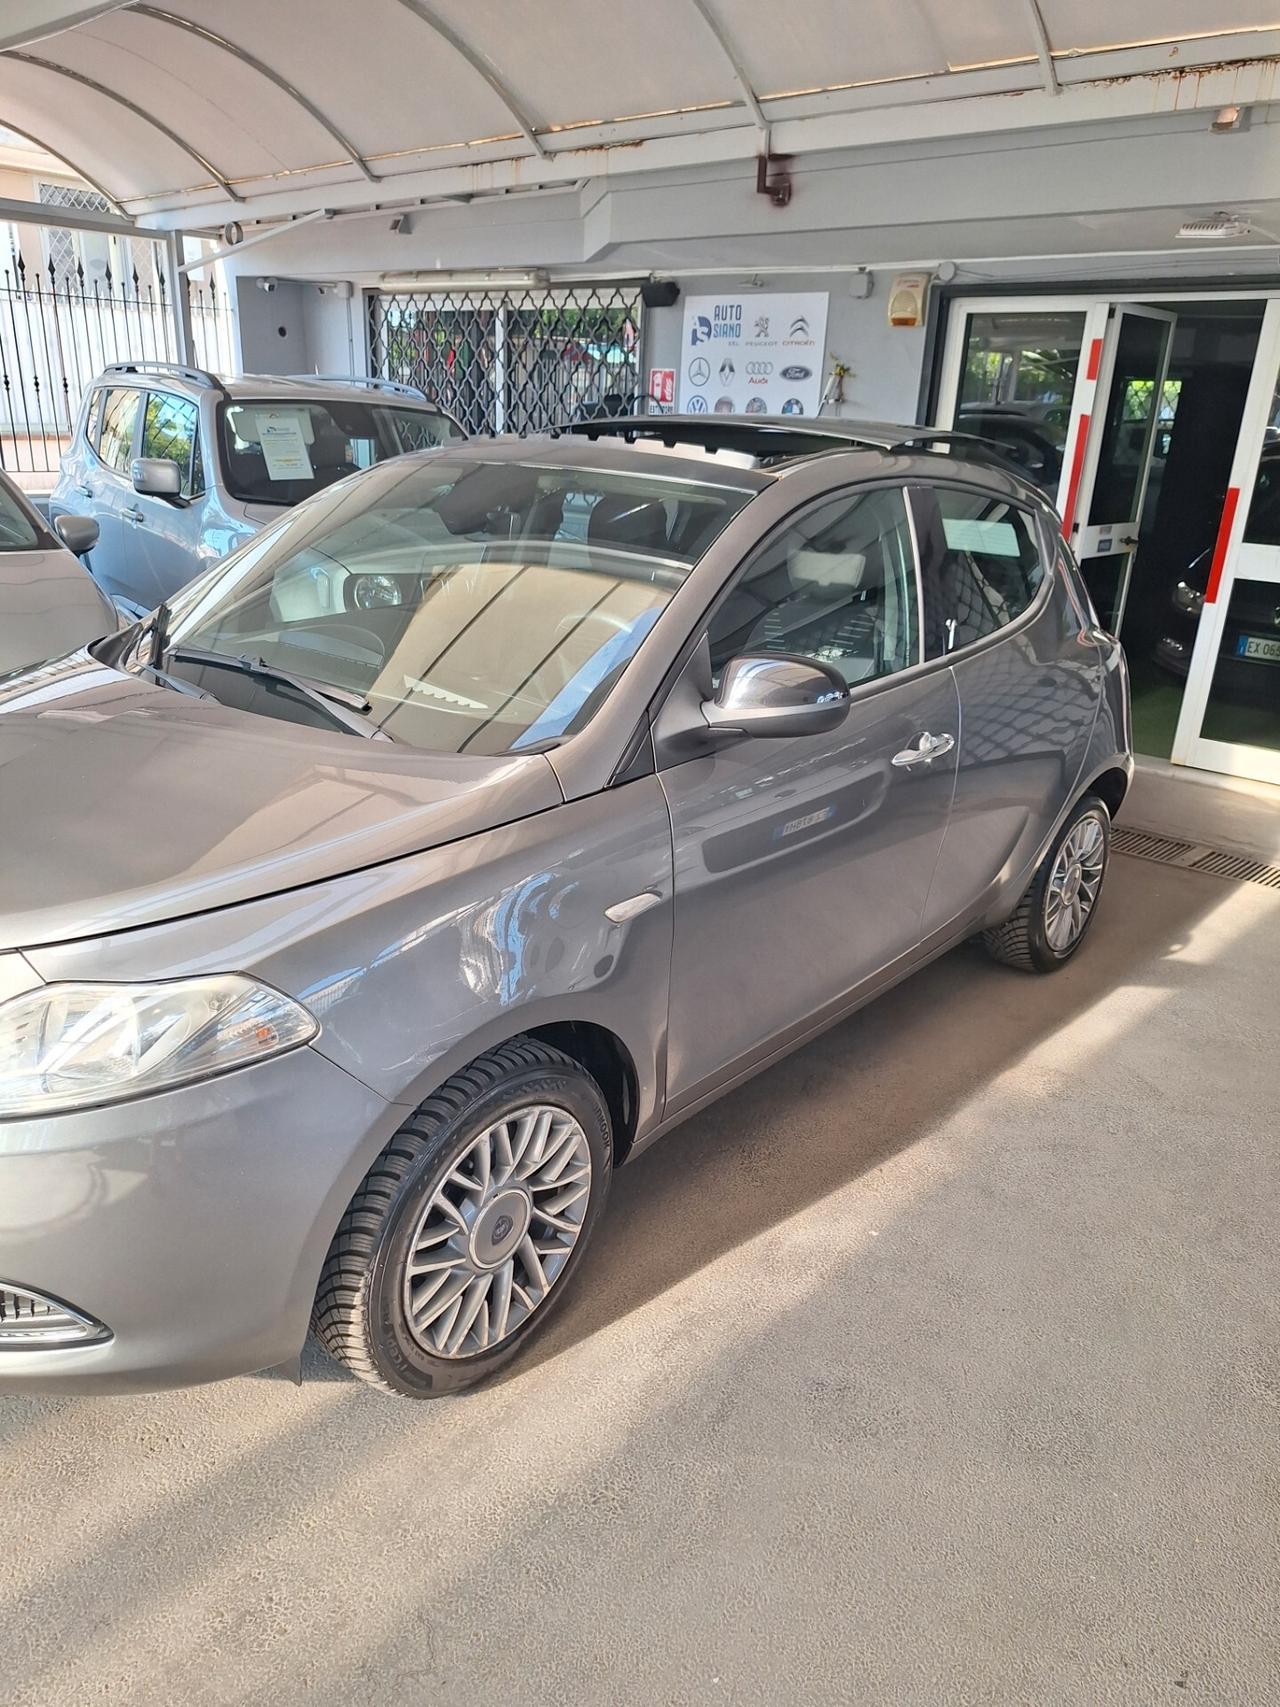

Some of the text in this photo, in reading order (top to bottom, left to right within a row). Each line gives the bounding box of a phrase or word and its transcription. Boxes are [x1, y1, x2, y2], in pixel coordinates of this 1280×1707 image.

[713, 304, 742, 321] AUTO
[713, 323, 742, 338] SIANO
[748, 376, 769, 385] Audi
[1248, 642, 1261, 654] EX
